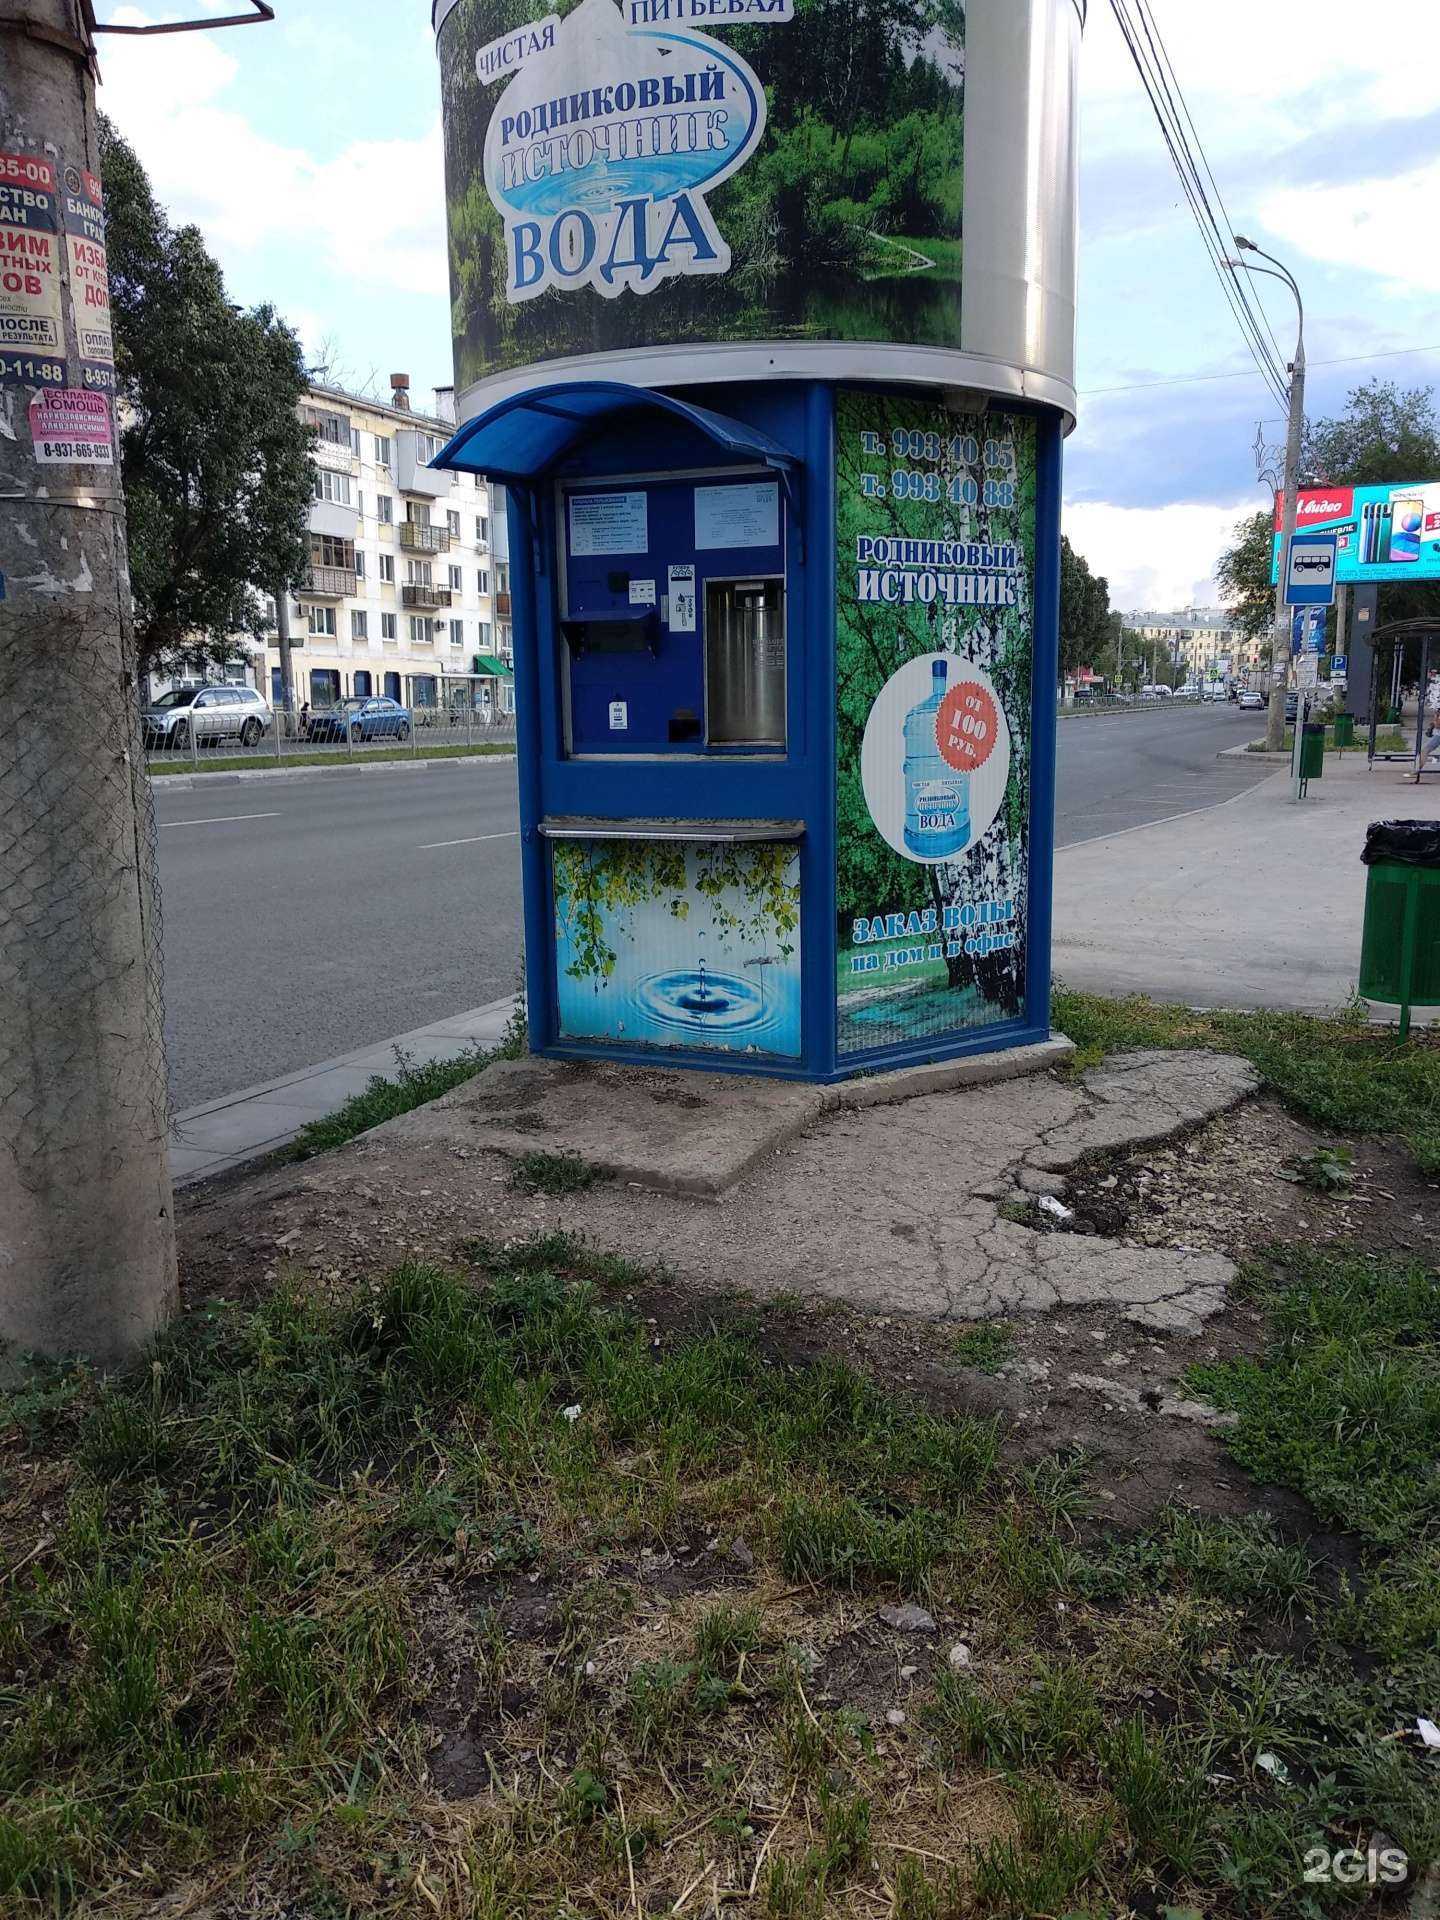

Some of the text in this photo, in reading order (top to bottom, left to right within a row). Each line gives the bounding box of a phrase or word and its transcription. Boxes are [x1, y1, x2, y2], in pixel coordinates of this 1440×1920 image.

[479, 25, 556, 76] ЧИСТАЯ
[501, 64, 726, 146] РОДНИКОВЫЙ
[501, 109, 729, 192] ИСТОЧНИК
[511, 192, 718, 289] ВОДА
[75, 265, 90, 279] ОТ
[2, 331, 54, 342] РЕЗУЛЬТАТА
[893, 427, 941, 461] 993
[950, 434, 979, 465] 40
[984, 438, 1014, 469] 85
[893, 469, 941, 502] 993
[947, 475, 979, 505] 40
[984, 479, 1014, 509] 88
[857, 535, 1017, 571] РОДНИКОВЫЙ
[857, 568, 1018, 605] ИСТОЧНИК
[951, 710, 987, 741] 100
[920, 813, 955, 829] ВОДА
[853, 899, 1014, 944] ЗАКАЗ ВОДЫ
[851, 931, 1015, 974] на дом и в офис
